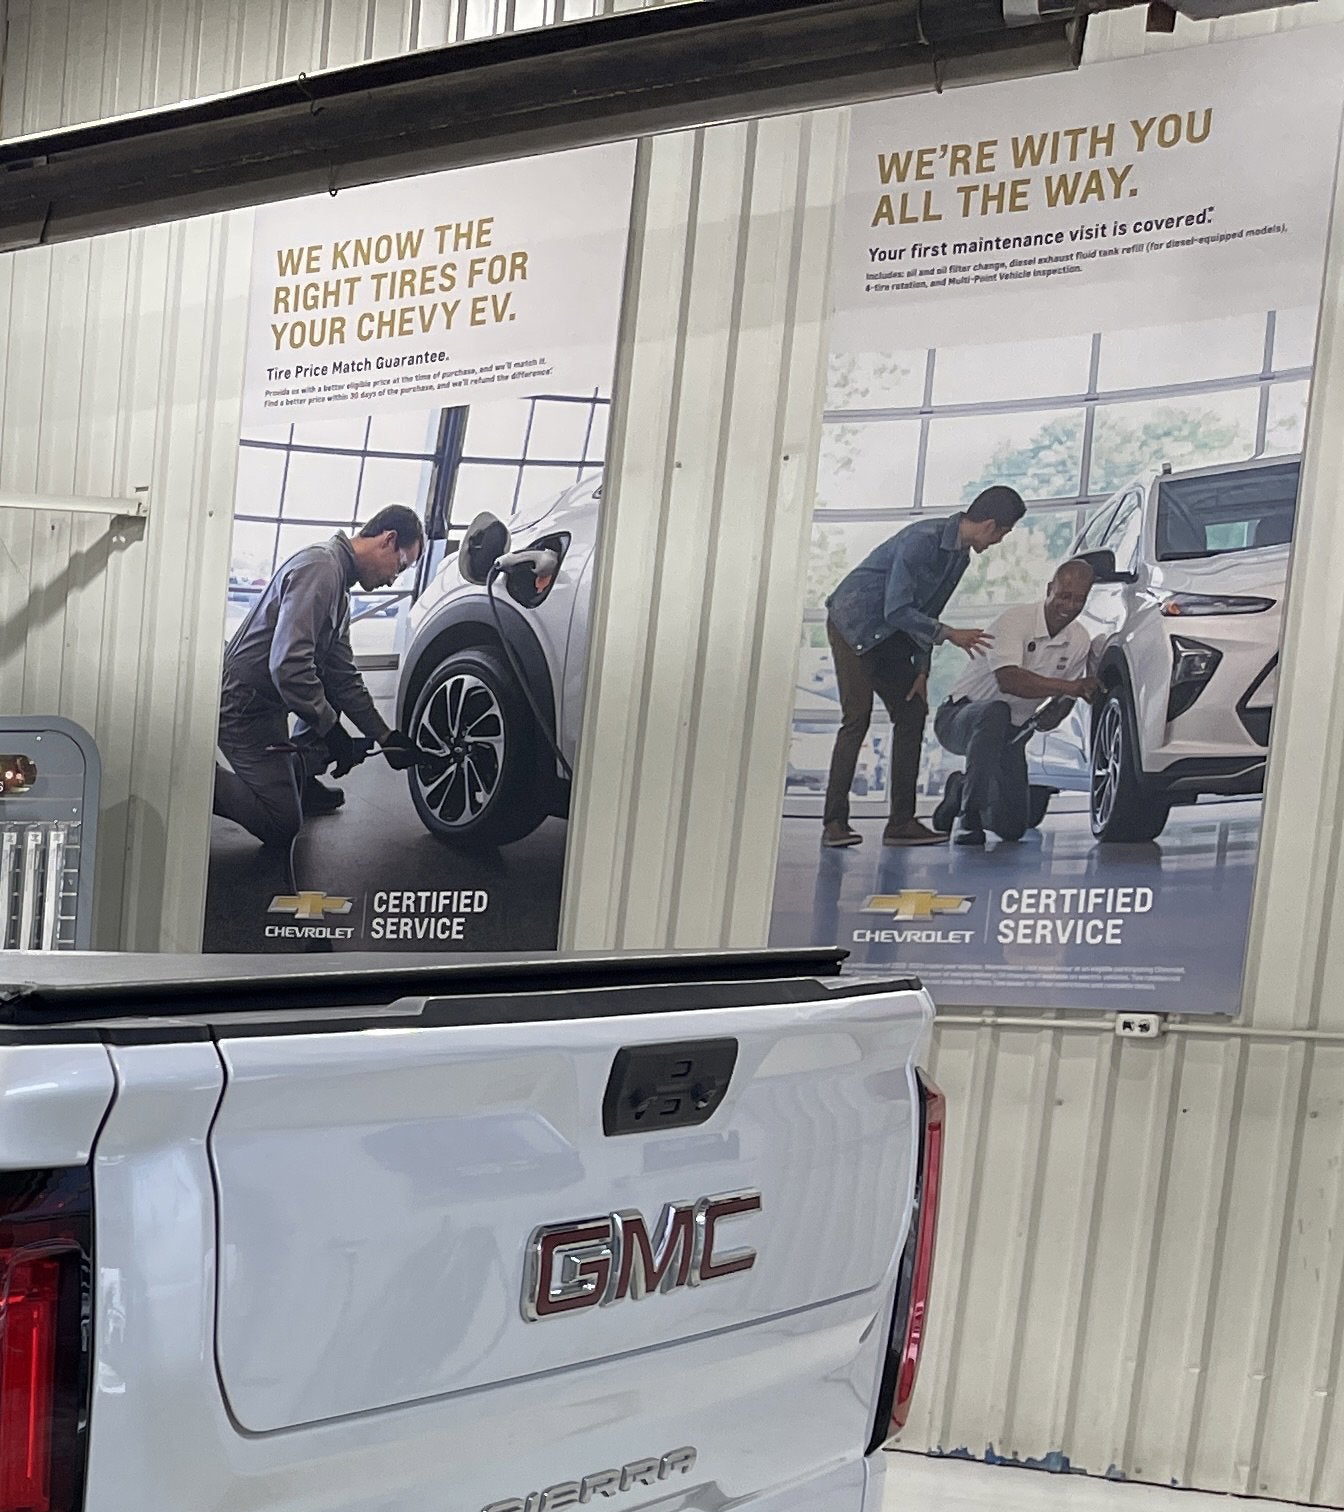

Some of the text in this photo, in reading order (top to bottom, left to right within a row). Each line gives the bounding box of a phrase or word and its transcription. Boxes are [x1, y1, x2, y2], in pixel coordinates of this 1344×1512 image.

[877, 107, 1214, 185] WE'RE WITH YOU
[870, 163, 1140, 228] ALL THE WAY.
[277, 216, 494, 277] WE KNOW THE
[868, 247, 907, 262] Your
[911, 242, 947, 259] first
[952, 230, 1064, 255] maintenance
[1069, 223, 1107, 242] visit
[1112, 220, 1127, 236] is
[918, 267, 935, 277] and
[937, 265, 947, 275] oil
[949, 263, 971, 274] filter
[973, 260, 1007, 273] change,
[1009, 257, 1036, 268] diesel
[1037, 253, 1074, 265] exhaust
[1075, 250, 1096, 260] fluid
[1098, 247, 1119, 258] tank
[1121, 243, 1144, 255] refill
[1146, 241, 1163, 253] (for
[1165, 229, 1243, 249] diesel-equipped
[273, 250, 529, 315] RIGHT TIRES FOR
[930, 278, 946, 288] and
[948, 273, 997, 286] Multi-Point
[999, 269, 1031, 280] Vehicle
[271, 290, 516, 351] YOUR CHEVY EV.
[266, 351, 450, 381] Tire Price Match Guarantee.
[401, 375, 413, 383] the
[415, 373, 431, 381] time
[432, 371, 440, 379] of
[479, 364, 493, 373] and
[360, 391, 377, 400] days
[378, 389, 385, 397] of
[387, 387, 399, 396] the
[436, 381, 450, 390] and
[496, 373, 509, 381] the
[373, 890, 489, 914] CERTIFIED
[1000, 886, 1154, 914] CERTIFIED
[264, 925, 355, 939] CHEVROLET
[370, 917, 466, 940] SERVICE
[852, 929, 975, 944] CHEVROLET
[996, 918, 1124, 945] SERVICE
[519, 1186, 763, 1324] GMC
